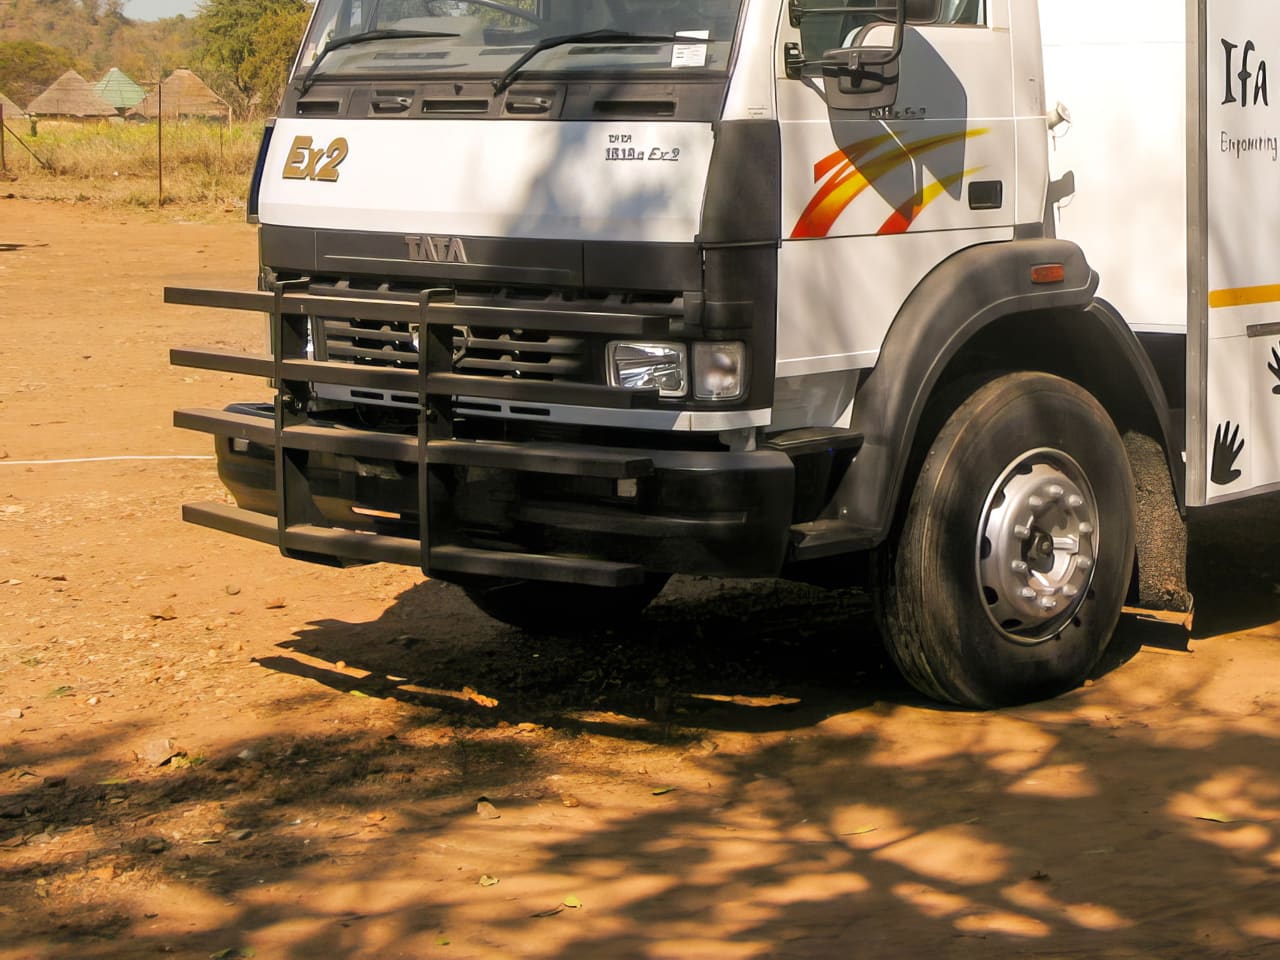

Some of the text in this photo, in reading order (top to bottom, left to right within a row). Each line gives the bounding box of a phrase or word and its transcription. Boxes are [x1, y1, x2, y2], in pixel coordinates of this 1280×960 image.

[1220, 38, 1268, 107] Ifa
[282, 135, 349, 182] Ex2
[1220, 130, 1278, 161] Empowering
[405, 236, 468, 263] TATA
